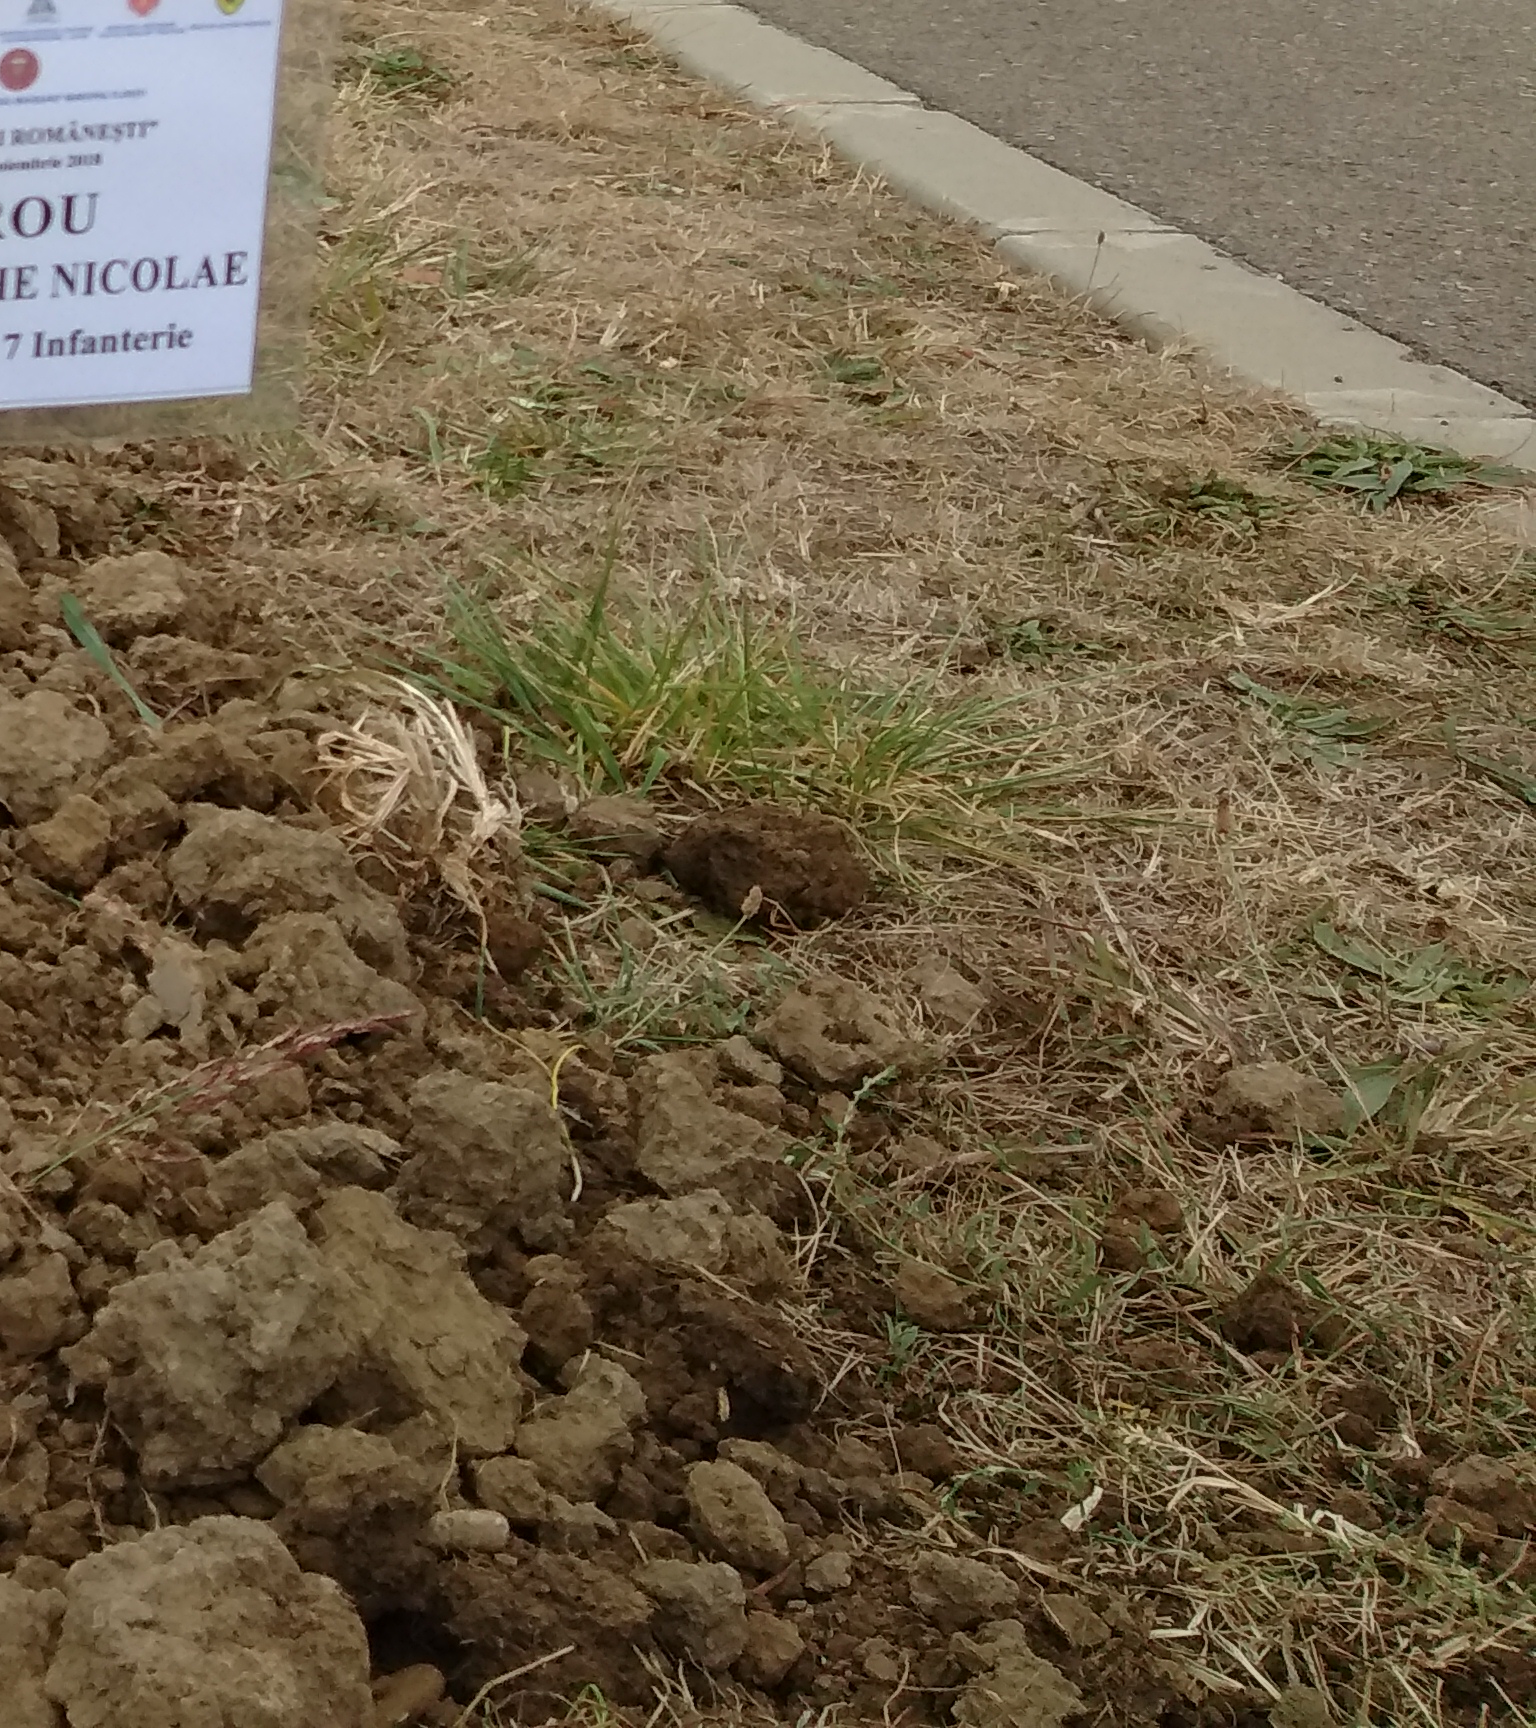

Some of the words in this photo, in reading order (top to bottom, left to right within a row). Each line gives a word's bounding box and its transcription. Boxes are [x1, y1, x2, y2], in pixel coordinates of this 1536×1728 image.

[50, 251, 248, 299] NICOLAE
[4, 333, 21, 361] 7
[32, 322, 195, 359] Infanterie
